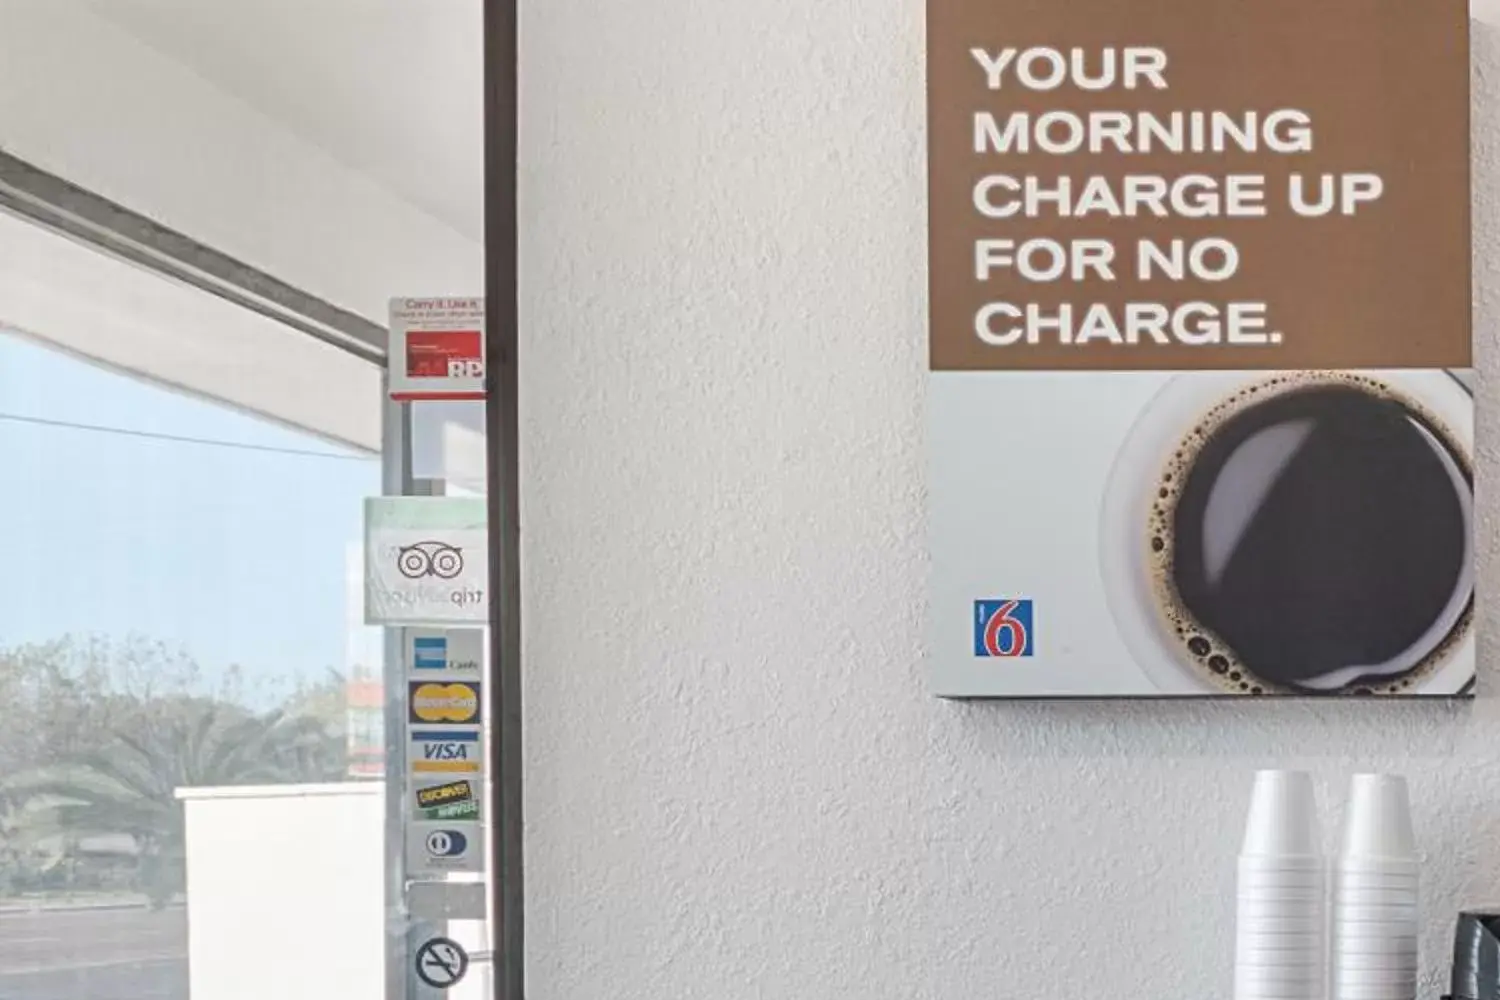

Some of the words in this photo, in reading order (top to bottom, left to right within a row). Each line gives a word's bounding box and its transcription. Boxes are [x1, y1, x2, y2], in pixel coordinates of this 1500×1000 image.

[971, 47, 1168, 90] YOUR
[973, 110, 1312, 154] MORNING
[973, 173, 1267, 218] CHARGE
[1289, 173, 1383, 217] UP
[975, 238, 1116, 281] FOR
[1138, 238, 1239, 281] NO
[974, 302, 1282, 345] CHARGE.
[984, 599, 1027, 657] 6
[423, 742, 467, 760] VISA
